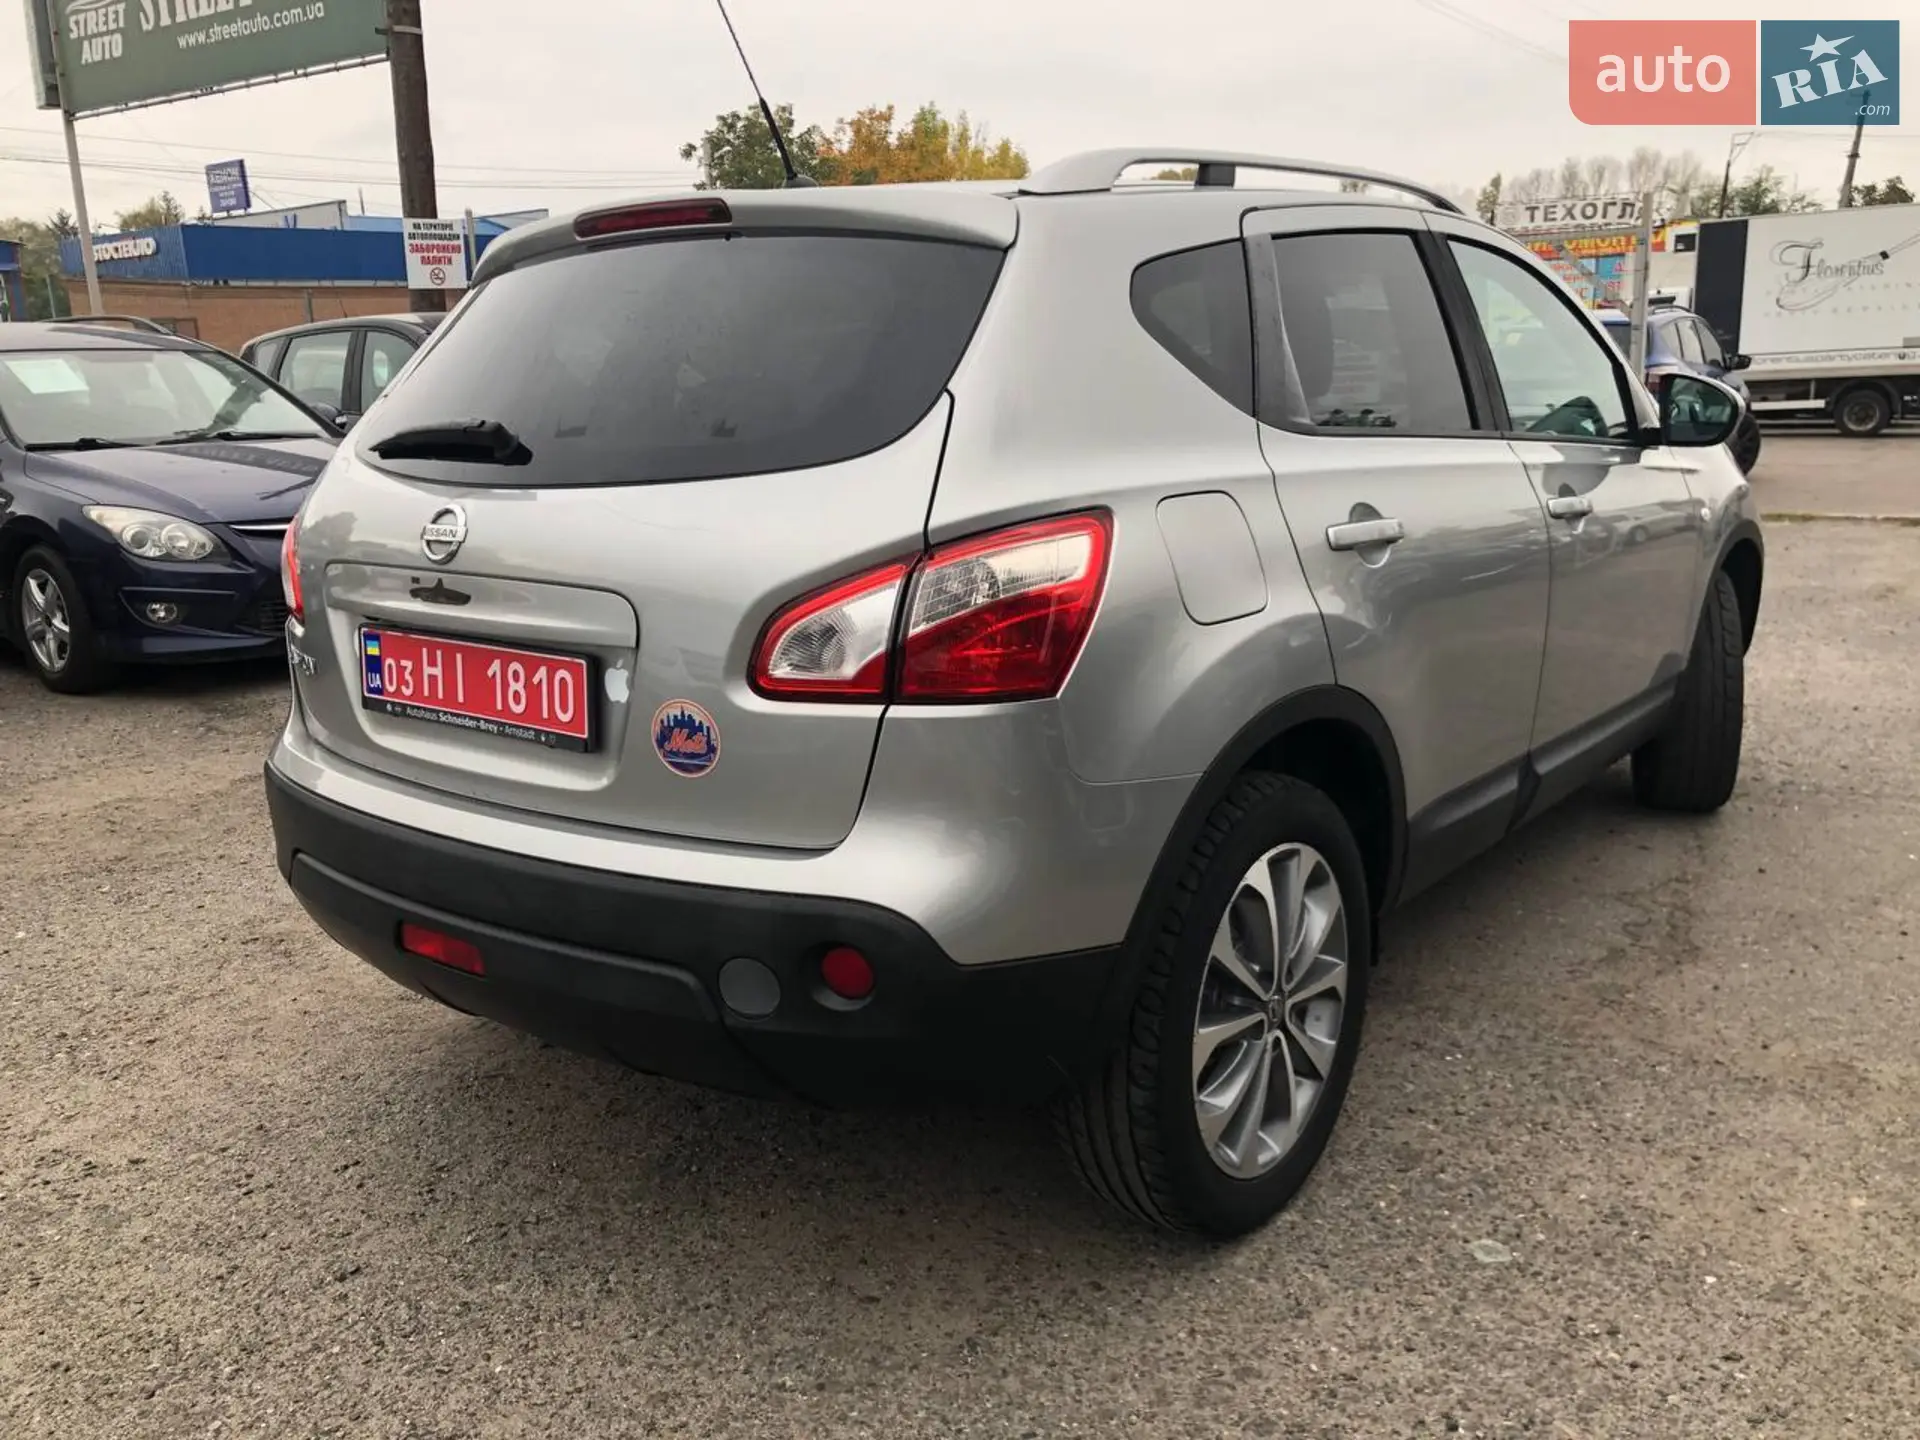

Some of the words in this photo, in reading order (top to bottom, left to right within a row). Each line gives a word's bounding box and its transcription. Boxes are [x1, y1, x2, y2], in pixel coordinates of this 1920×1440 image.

[69, 3, 125, 39] STREET
[176, 1, 325, 49] www.streetauto.com.ua
[81, 33, 123, 65] AUTO
[409, 243, 462, 254] ЗАБОРОНЕНО
[421, 255, 453, 266] ПАЛИТИ
[367, 672, 382, 689] UA
[486, 658, 576, 723] 1810
[406, 706, 438, 721] Autohaus
[438, 711, 499, 734] Schneider-Brey
